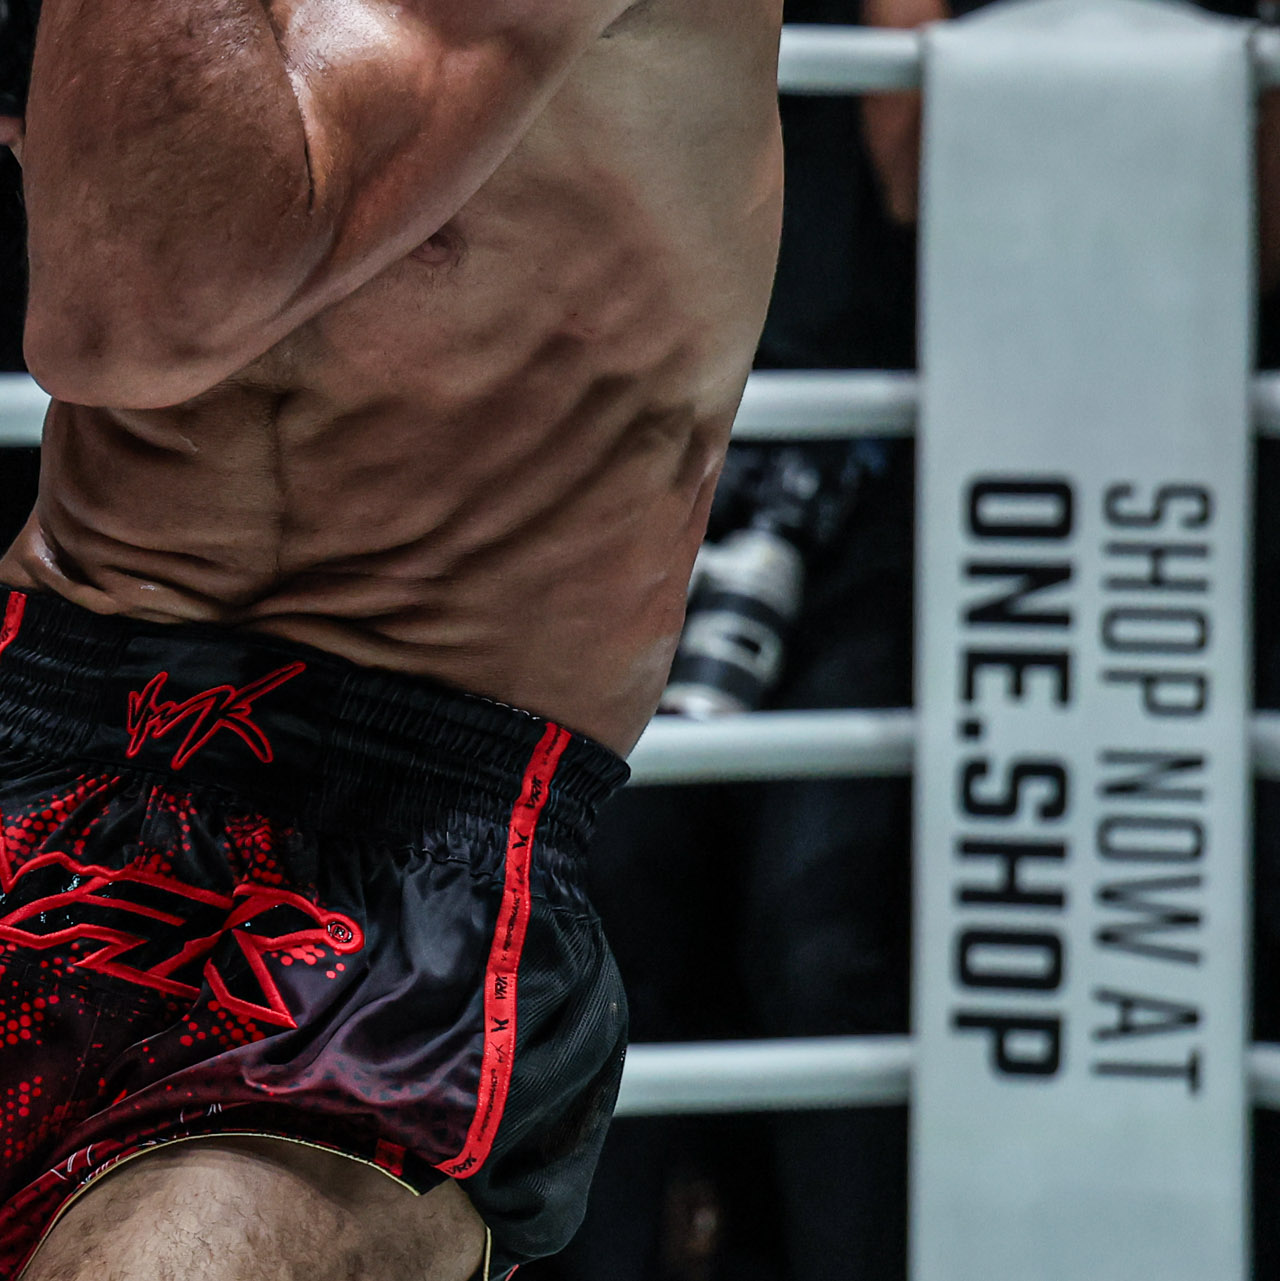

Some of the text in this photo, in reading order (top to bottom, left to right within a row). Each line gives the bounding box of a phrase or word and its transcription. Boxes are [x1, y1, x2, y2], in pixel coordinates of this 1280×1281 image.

[952, 475, 1077, 1082] ONE.SHOP
[1091, 481, 1215, 1098] SHOP NOW AT
